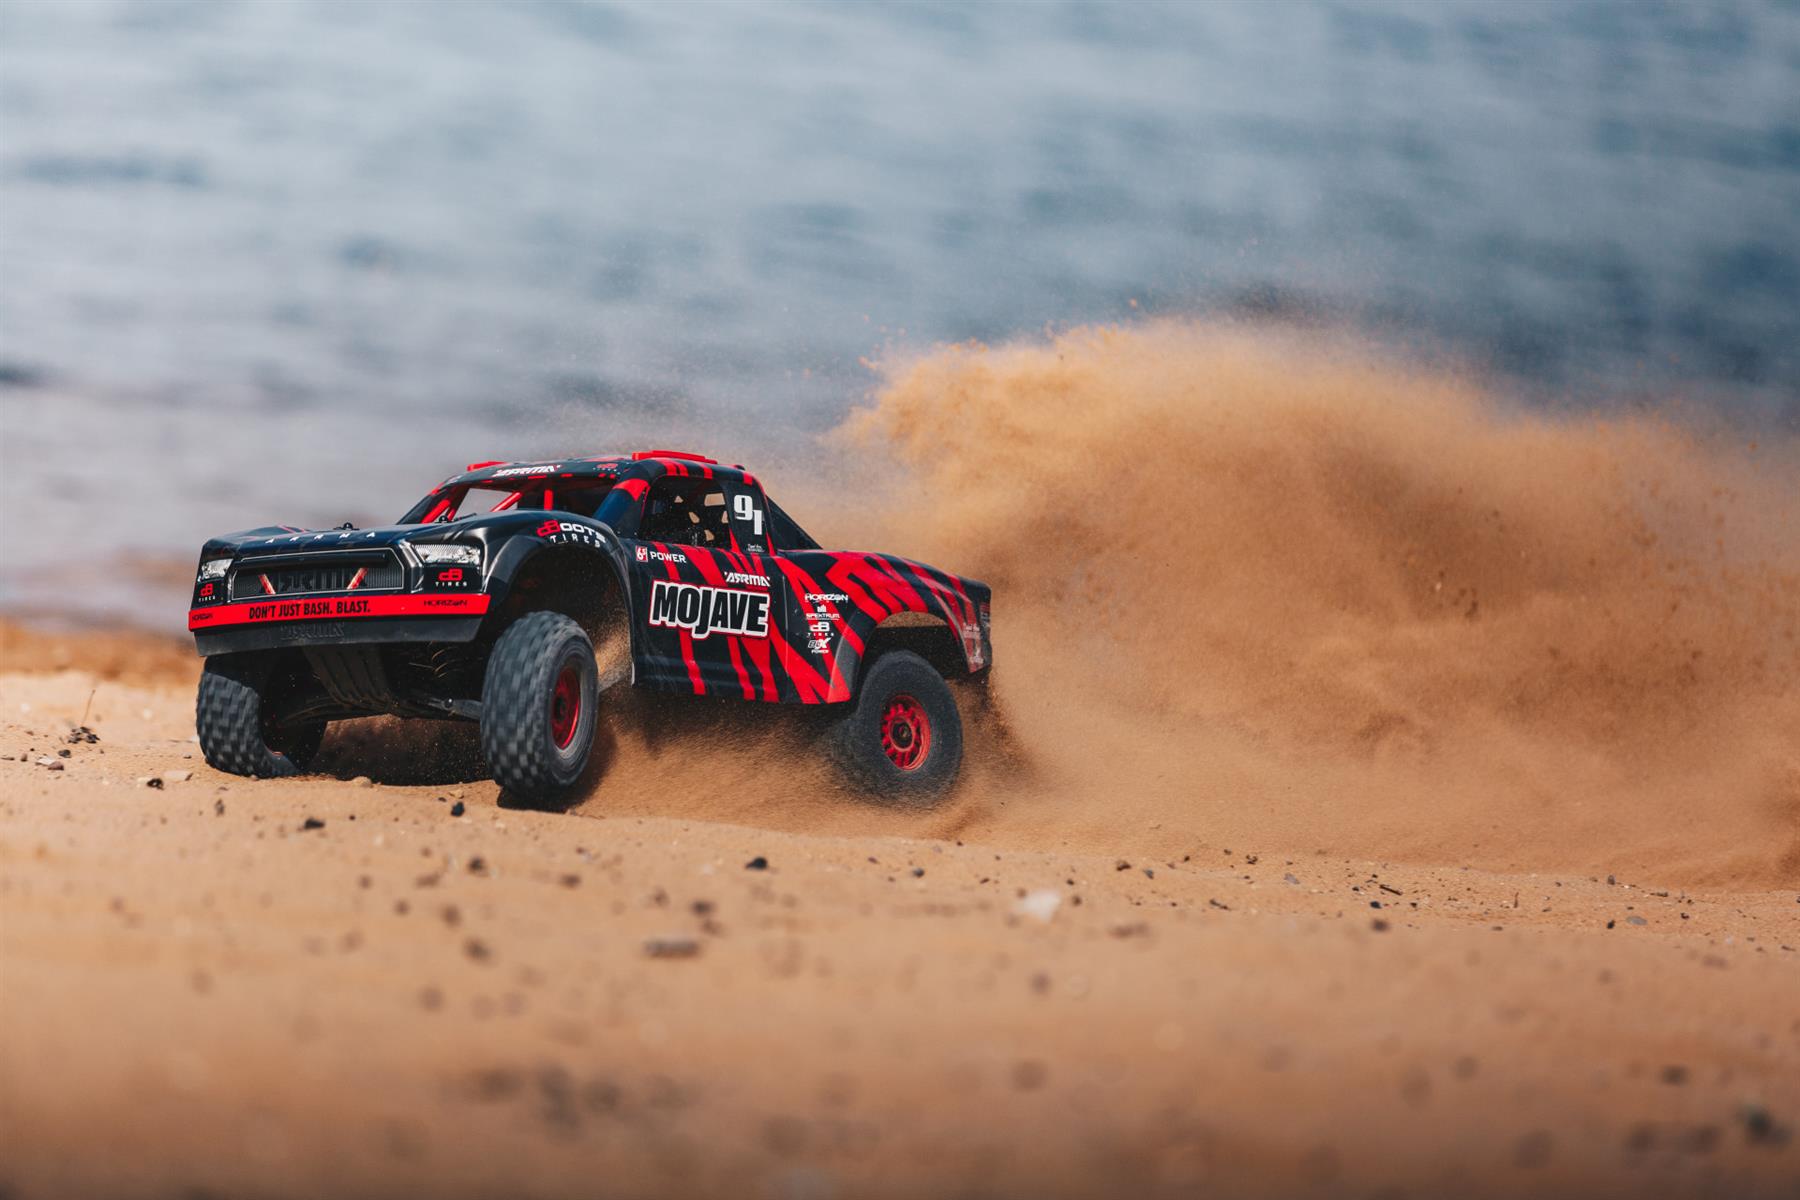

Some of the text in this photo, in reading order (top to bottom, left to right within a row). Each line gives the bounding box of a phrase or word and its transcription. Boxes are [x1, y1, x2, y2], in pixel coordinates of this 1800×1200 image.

[650, 551, 687, 563] POWER
[249, 600, 371, 619] DON'T JUST BASH. BLAST.
